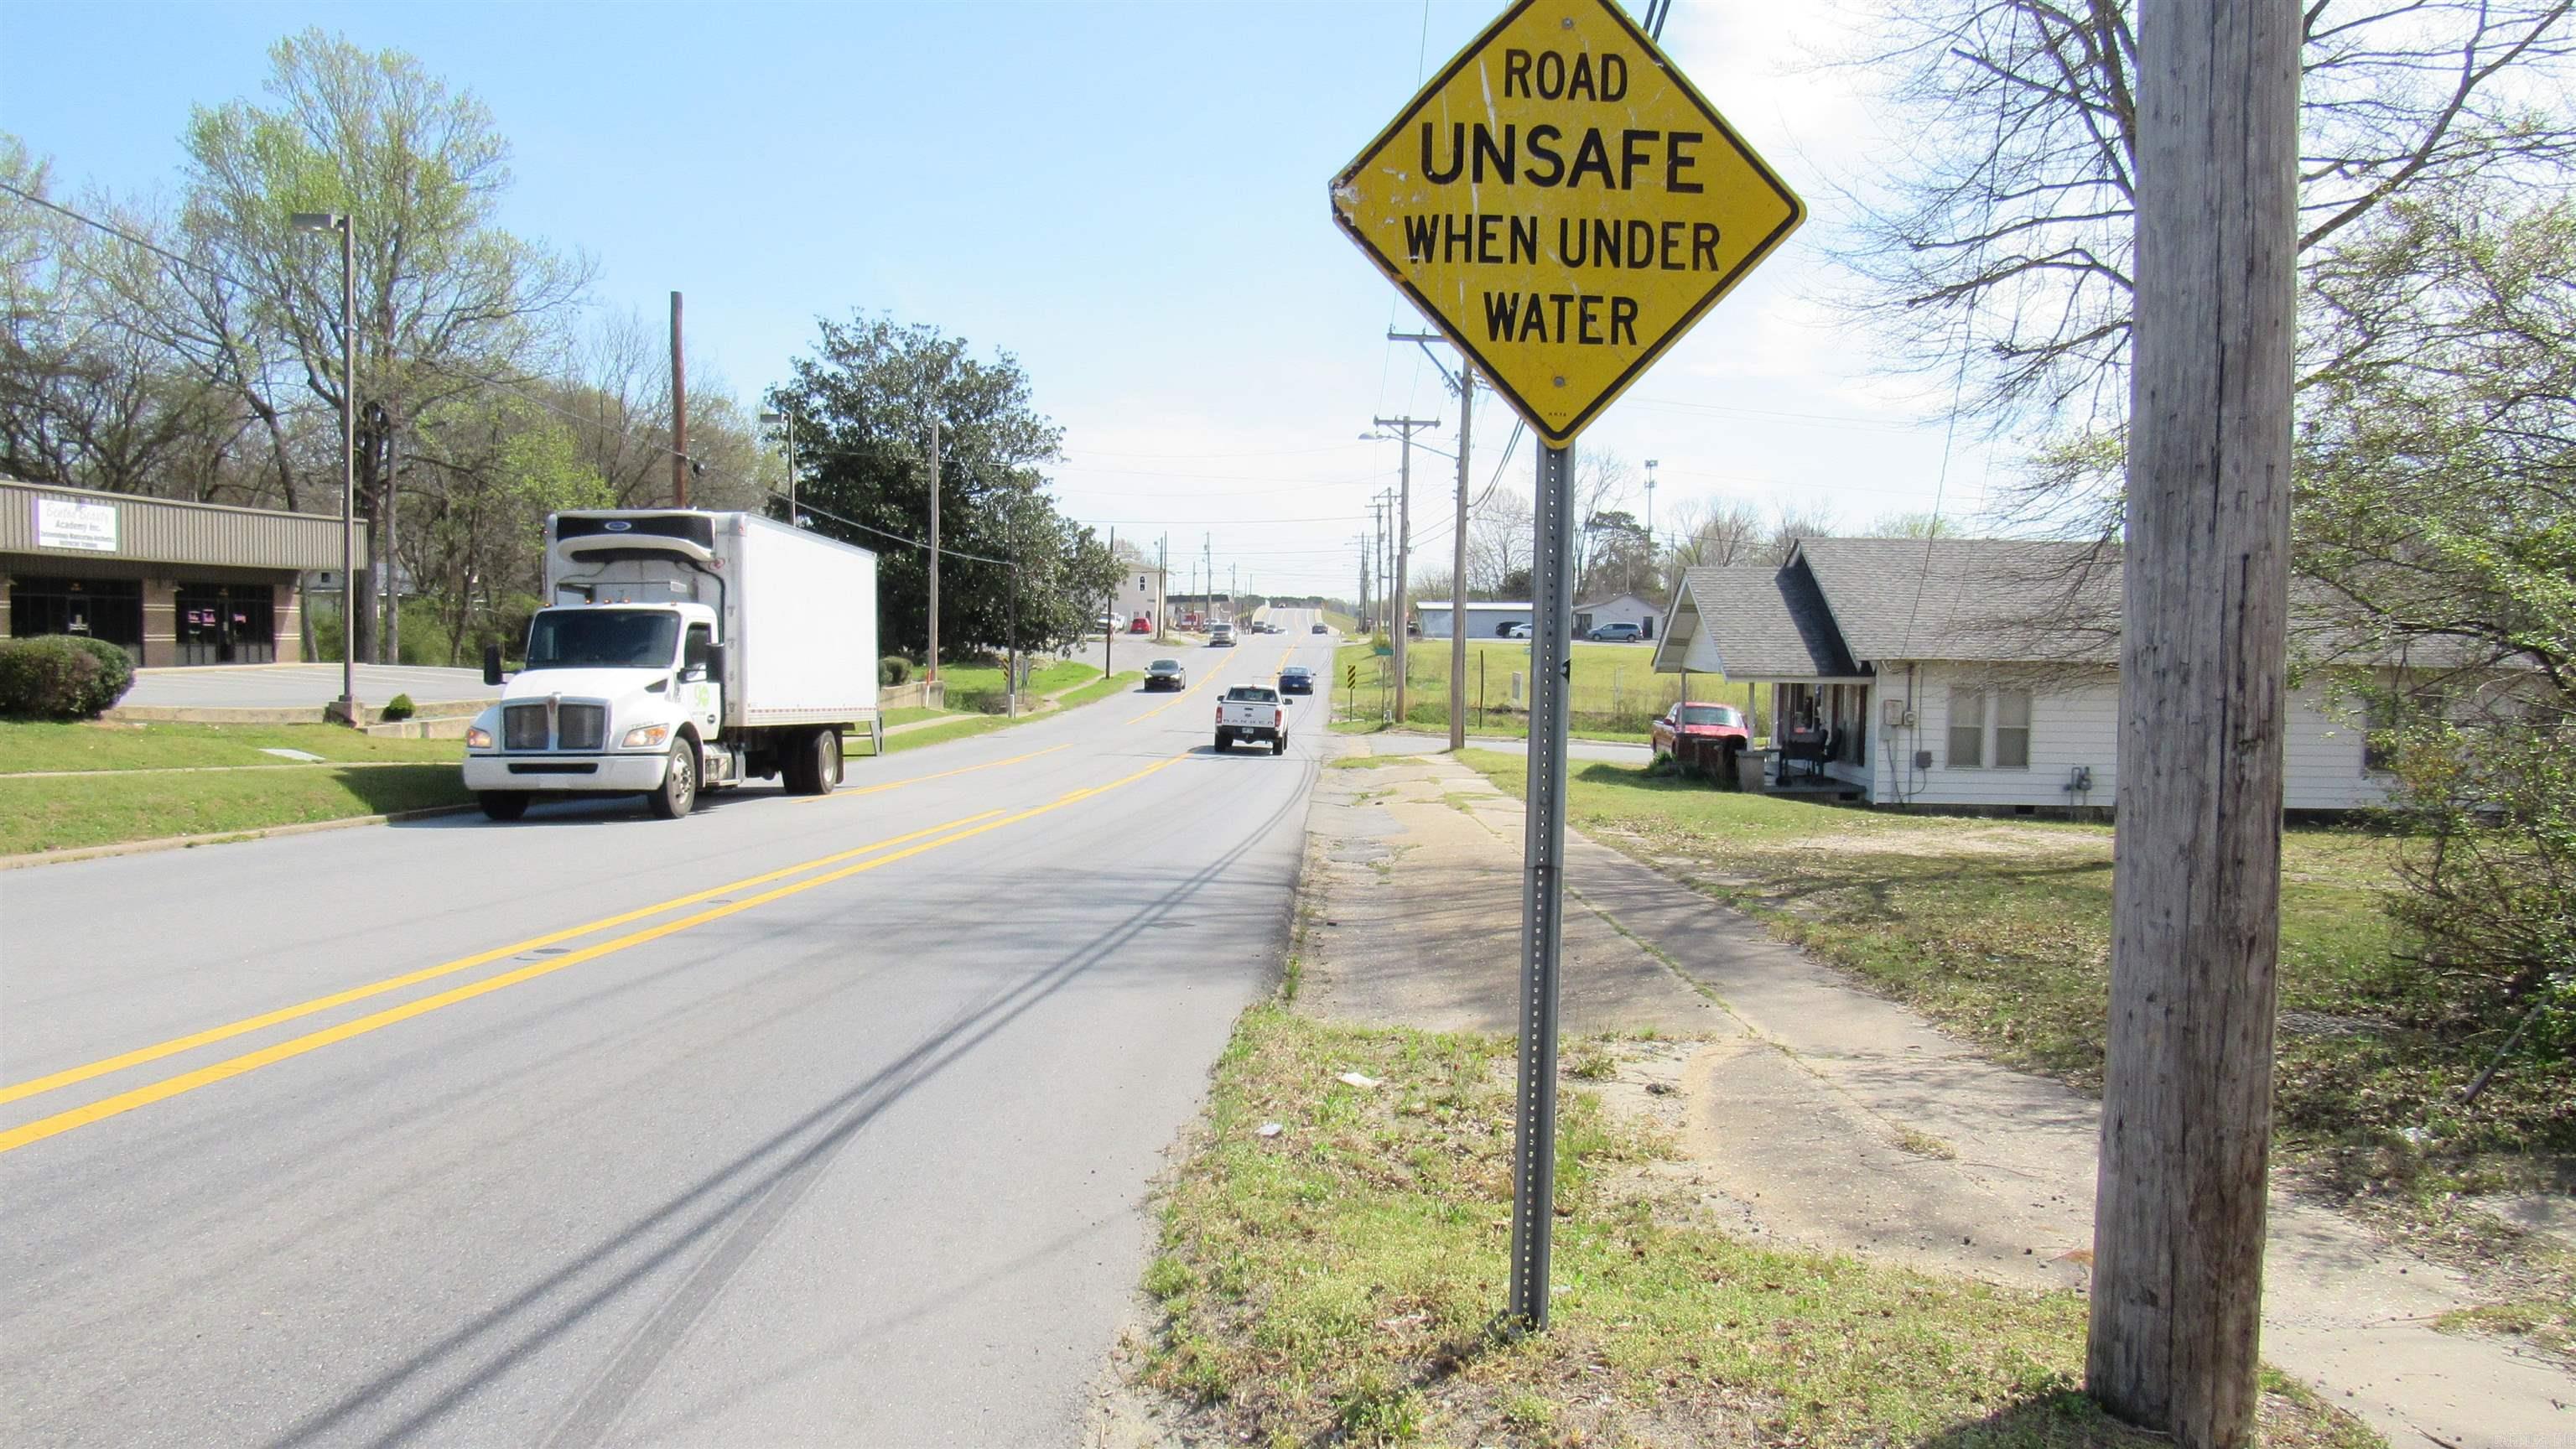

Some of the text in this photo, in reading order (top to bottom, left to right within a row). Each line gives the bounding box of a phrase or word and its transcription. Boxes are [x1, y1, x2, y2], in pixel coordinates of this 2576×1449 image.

[1504, 49, 1628, 102] ROAD
[1420, 122, 1704, 194] UNSAFE
[1404, 215, 1721, 272] WHEN UNDER
[1483, 291, 1639, 345] WATER
[55, 519, 87, 532] Academy
